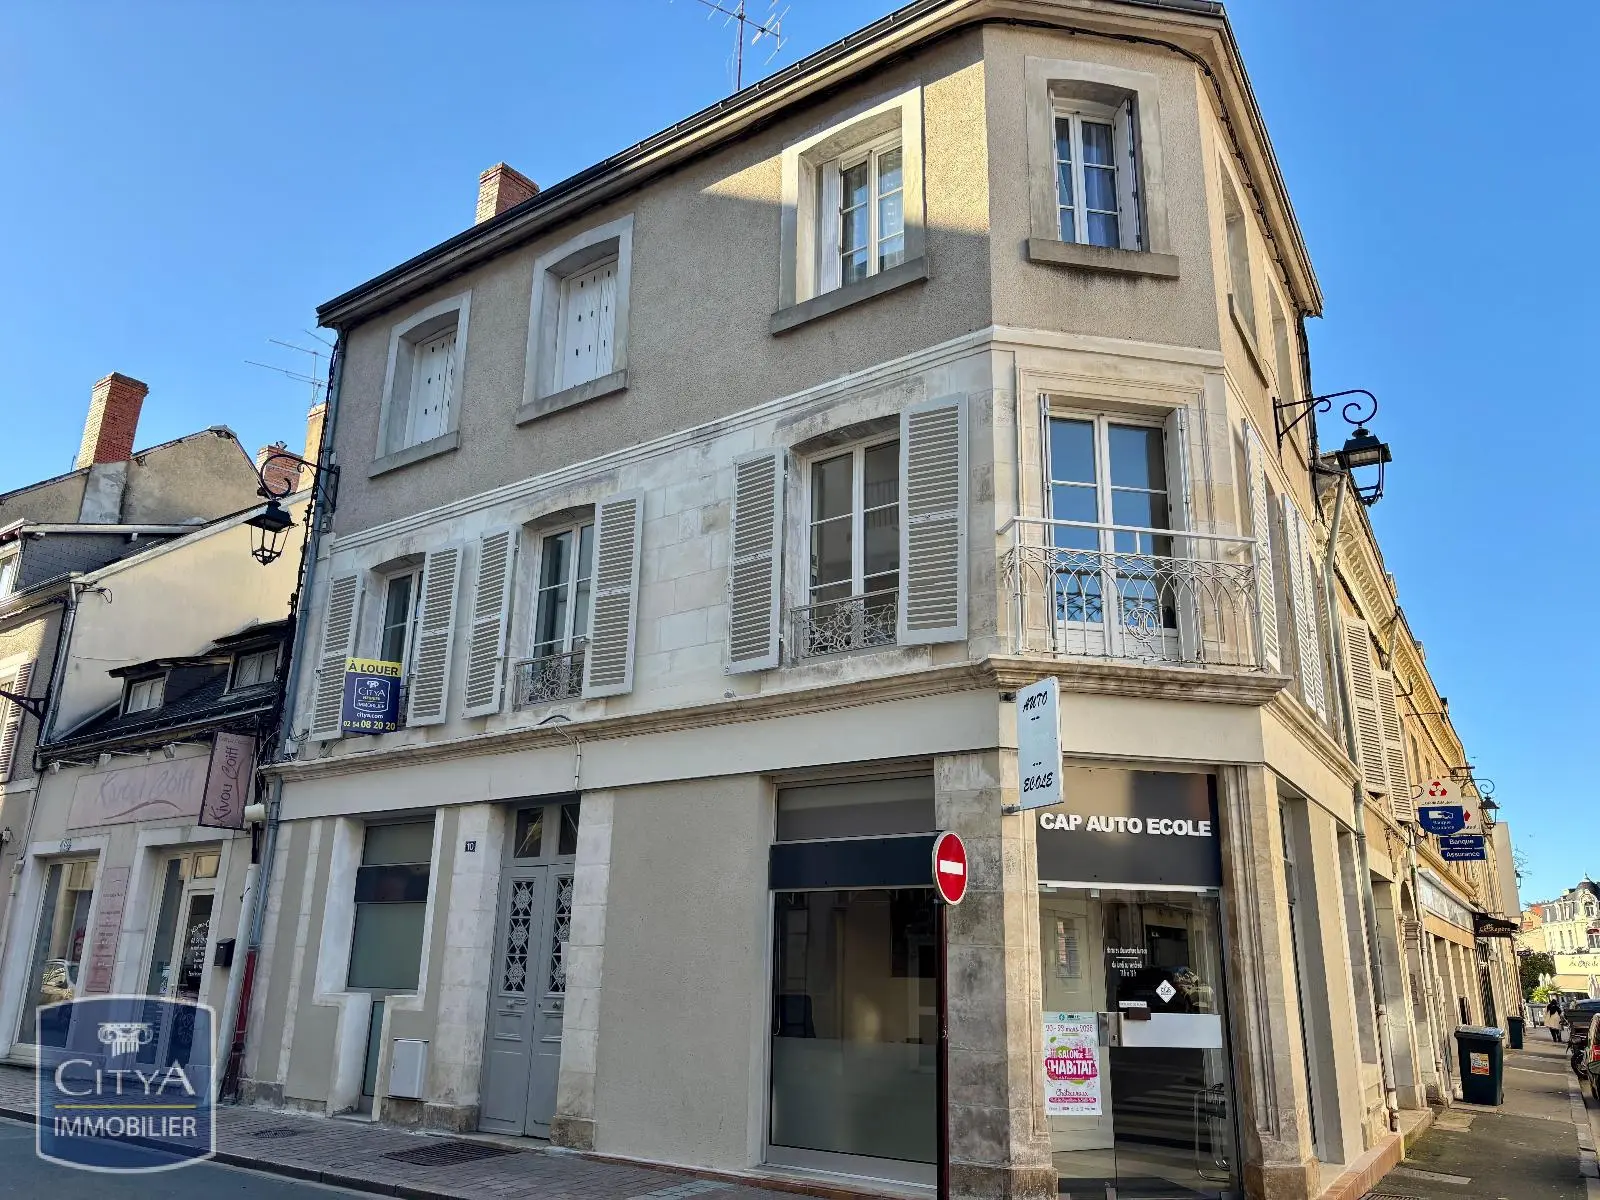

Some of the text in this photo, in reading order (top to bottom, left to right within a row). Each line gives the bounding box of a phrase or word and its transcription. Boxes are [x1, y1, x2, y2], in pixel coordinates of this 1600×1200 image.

[348, 659, 398, 676] À LOUER
[358, 687, 386, 697] CITYA
[1022, 690, 1048, 713] AUTO
[356, 711, 384, 719] citya.com
[360, 719, 372, 729] 08
[373, 721, 383, 730] 20
[385, 721, 396, 731] 20
[208, 784, 233, 826] Kivou
[221, 747, 240, 781] Coiff
[1023, 772, 1054, 793] ECOLE
[1039, 813, 1212, 837] CAP AUTO ECOLE
[466, 842, 474, 851] 10
[1449, 838, 1474, 846] Banque
[1058, 1049, 1078, 1059] SALON
